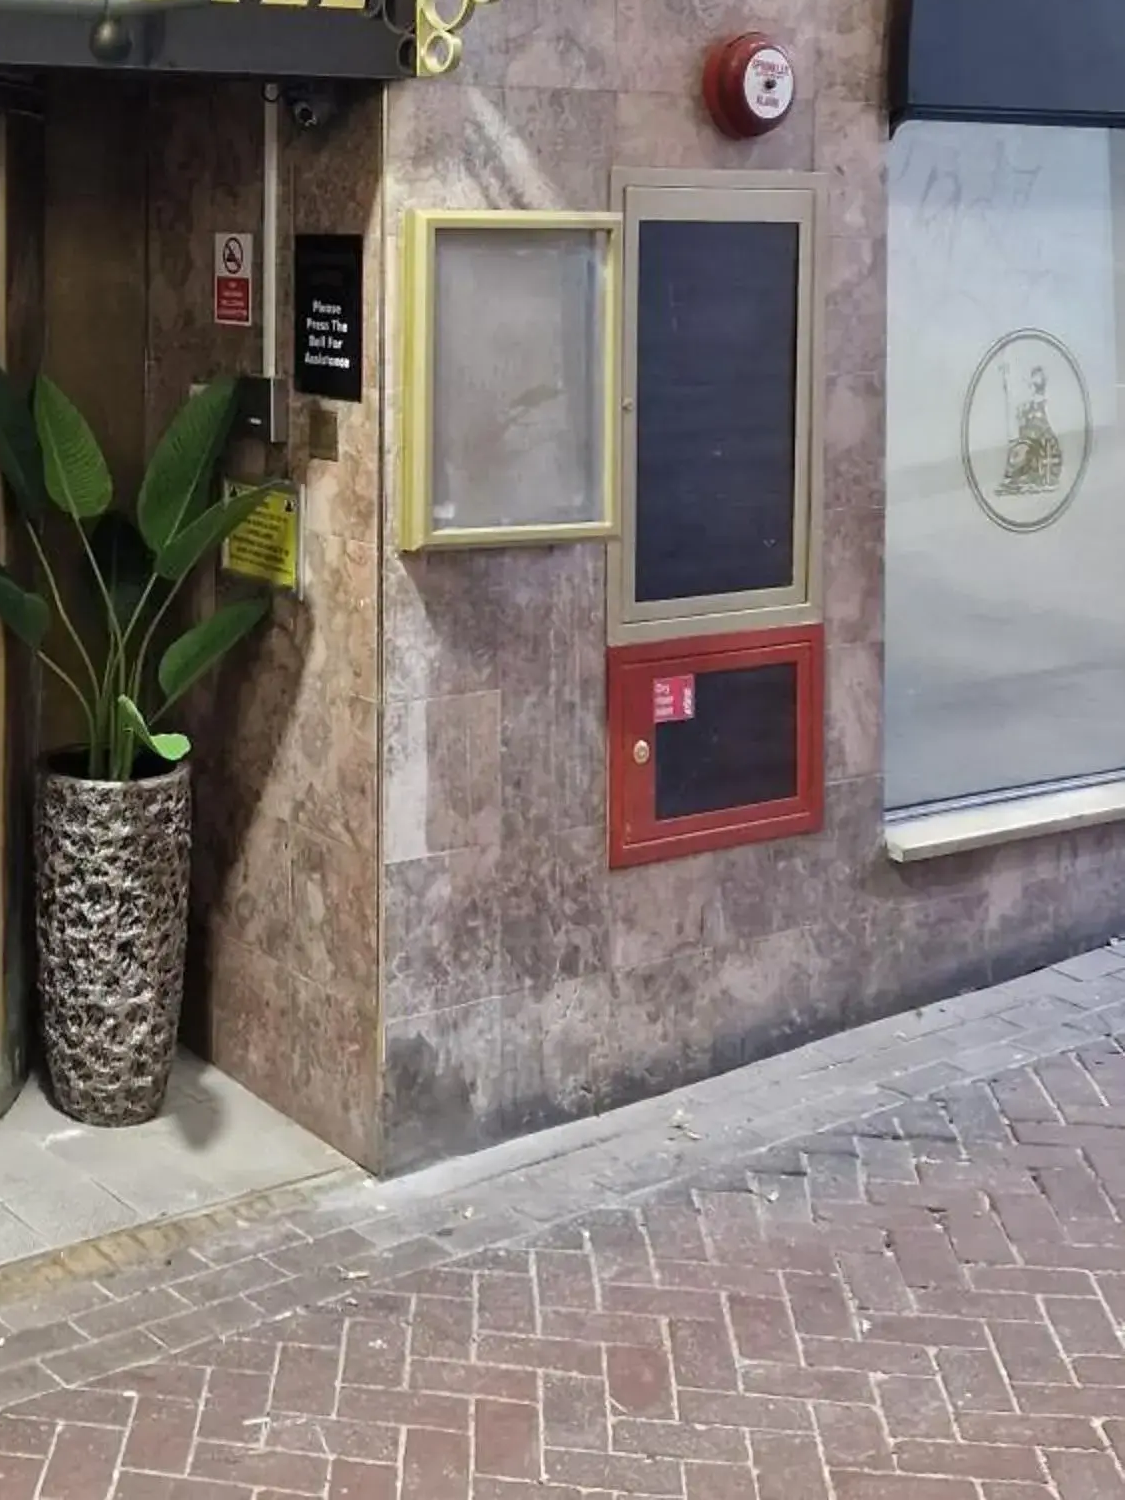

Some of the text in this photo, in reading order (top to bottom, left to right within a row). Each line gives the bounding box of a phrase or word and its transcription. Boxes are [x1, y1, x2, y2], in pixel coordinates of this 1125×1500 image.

[312, 300, 342, 314] Please
[306, 317, 348, 333] Press The
[304, 352, 350, 369] Assistance
